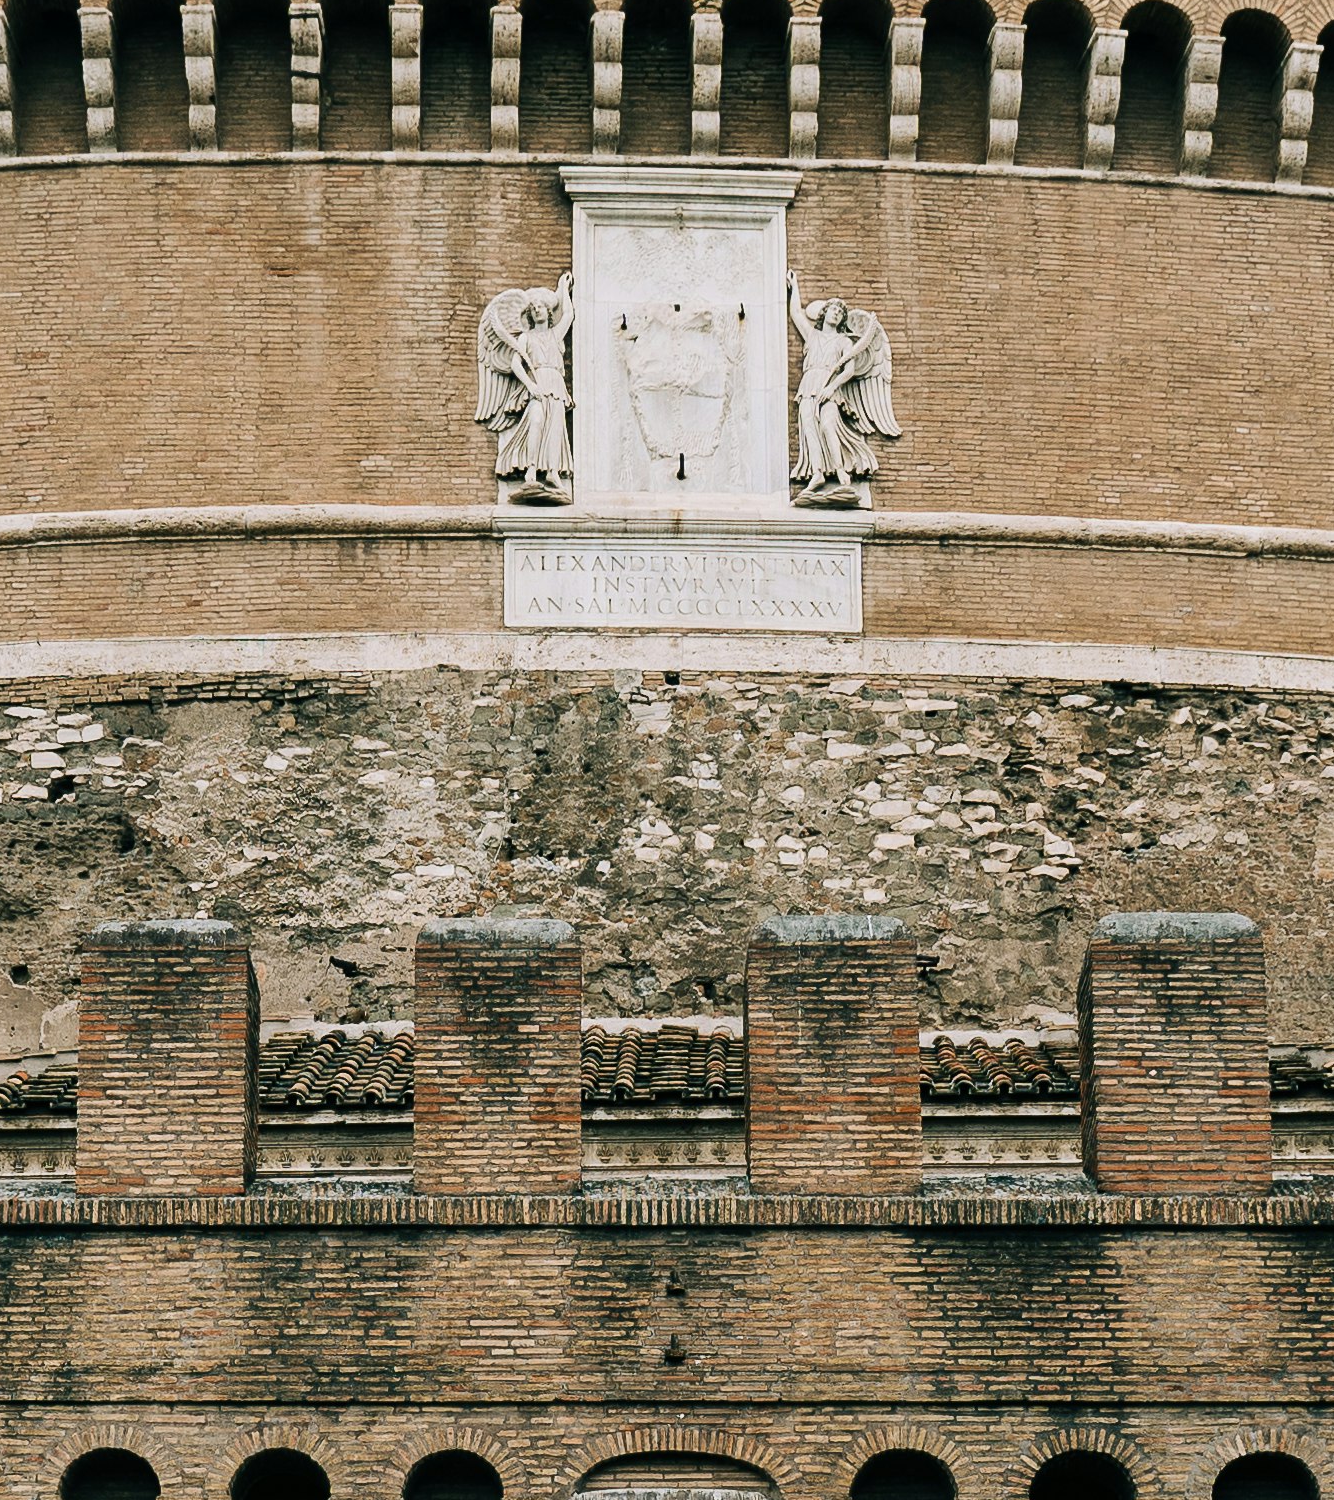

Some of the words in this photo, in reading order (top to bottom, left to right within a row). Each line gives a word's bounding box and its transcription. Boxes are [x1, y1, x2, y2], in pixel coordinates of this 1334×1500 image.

[520, 554, 679, 573] ALEXANDER
[717, 556, 784, 575] PONT
[790, 558, 845, 577] MAX
[592, 576, 776, 595] INSTAVRAVIT
[528, 597, 563, 613] AN
[575, 597, 619, 614] SAL
